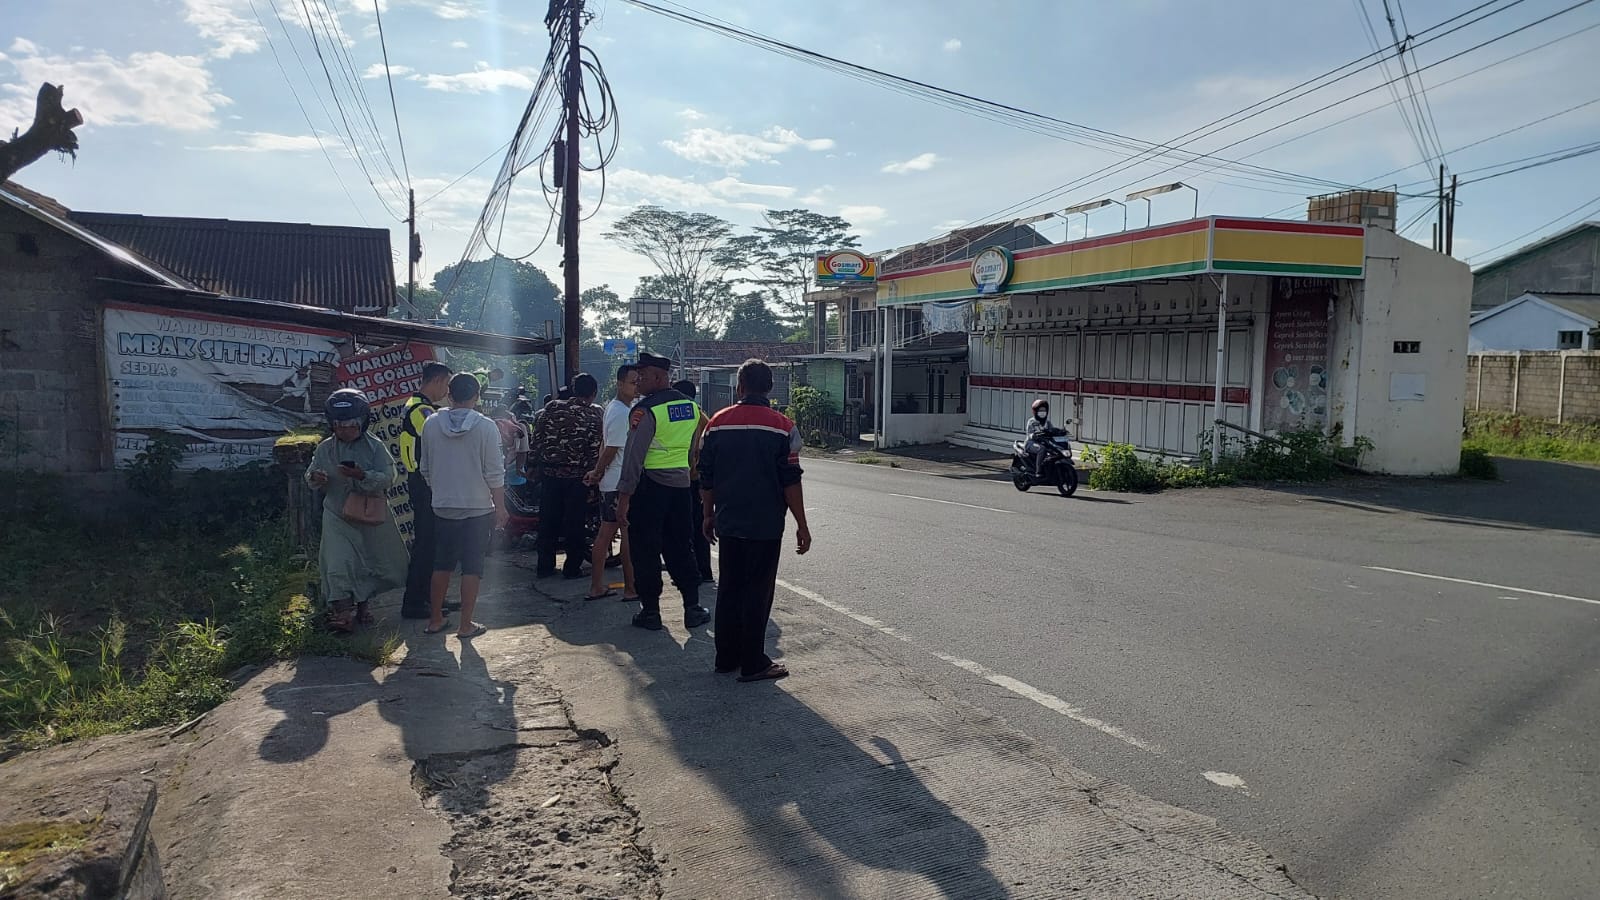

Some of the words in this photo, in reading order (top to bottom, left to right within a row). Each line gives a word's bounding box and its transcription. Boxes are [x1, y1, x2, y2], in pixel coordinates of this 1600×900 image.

[831, 261, 861, 269] Gosmart
[118, 331, 196, 360] MBAK
[199, 338, 249, 365] SITI
[345, 348, 413, 375] WARUNG
[373, 360, 428, 384] GOREN
